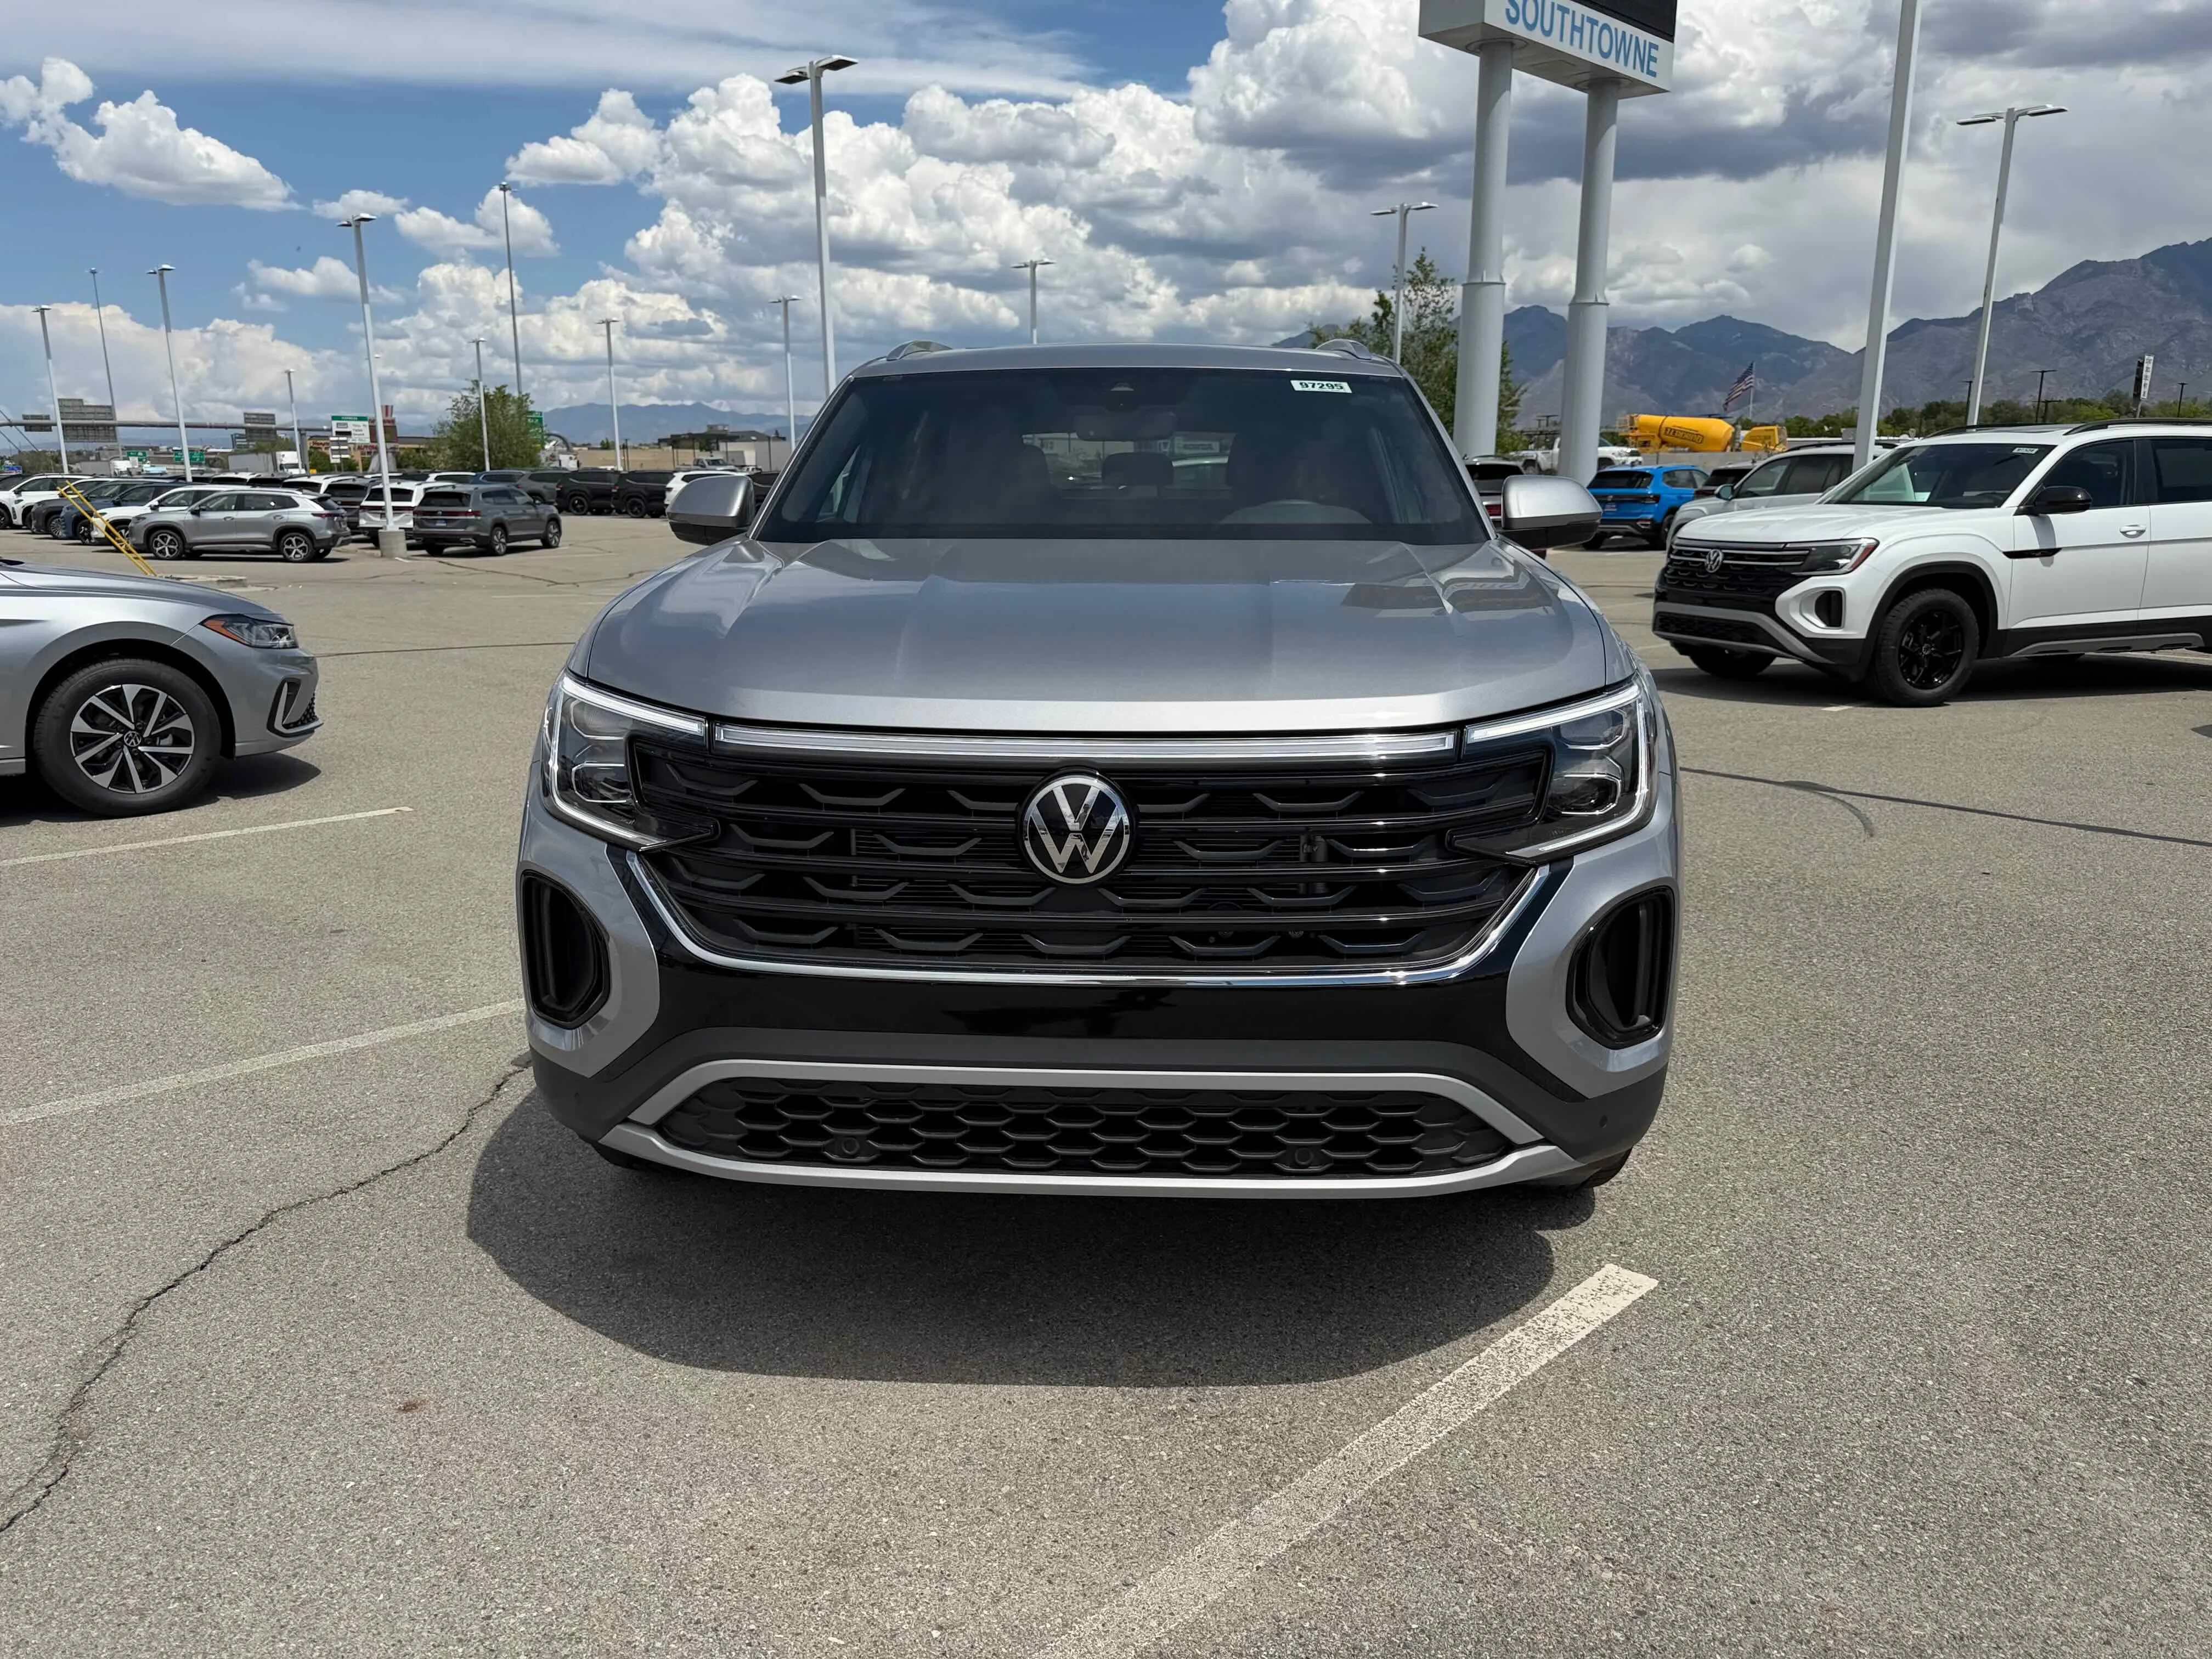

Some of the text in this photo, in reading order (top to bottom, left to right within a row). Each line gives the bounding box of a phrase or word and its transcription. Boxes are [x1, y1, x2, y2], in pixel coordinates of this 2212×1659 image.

[1505, 0, 1658, 77] SOUTHTOWNE
[1299, 382, 1344, 390] 97295
[1024, 775, 1130, 884] VW
